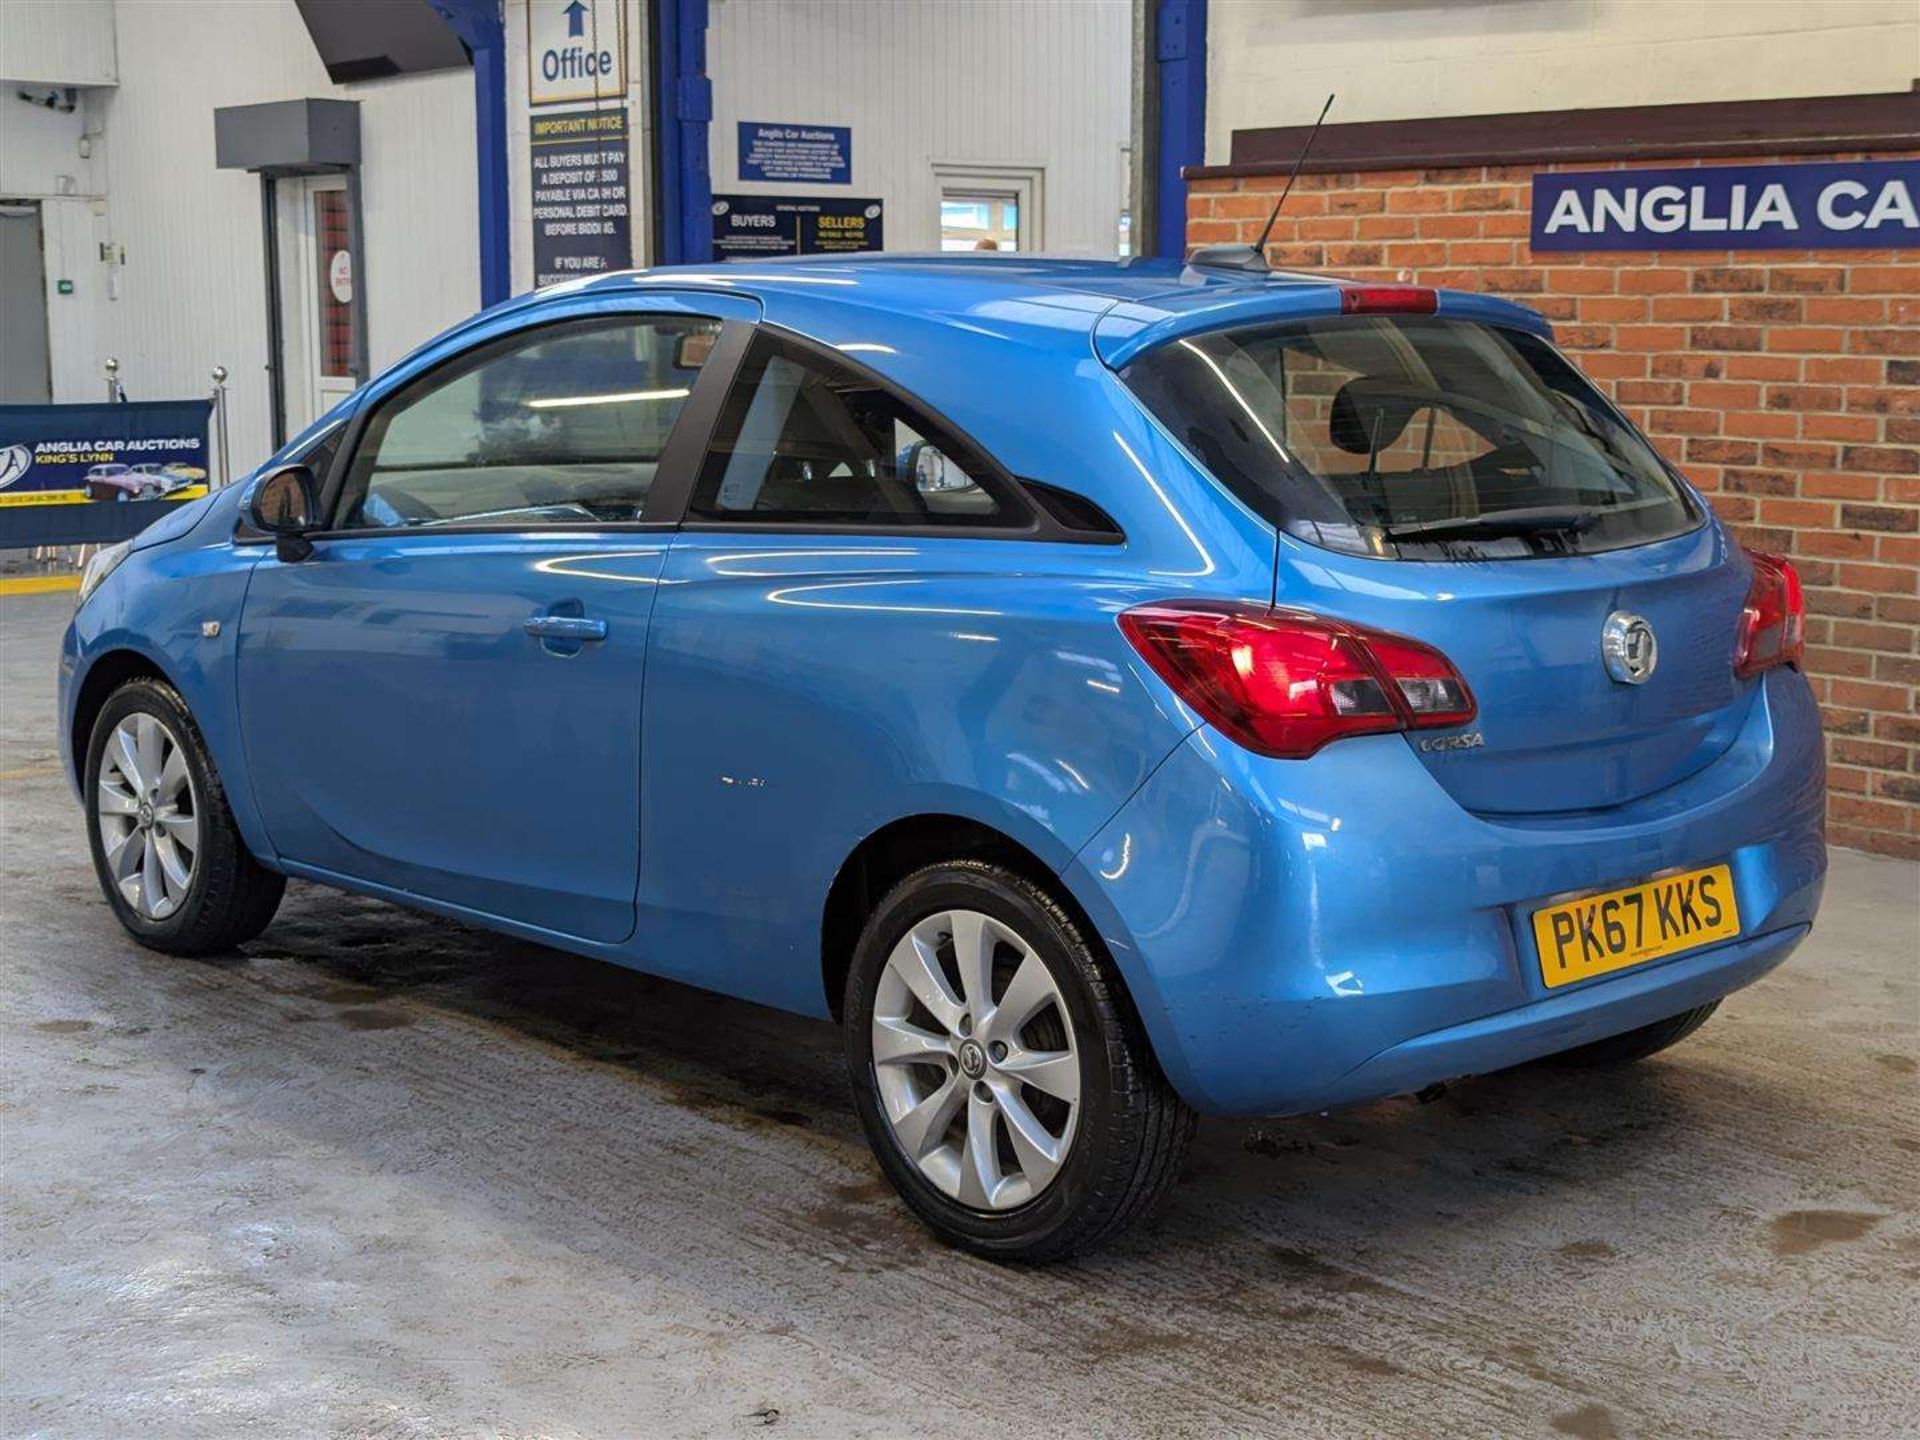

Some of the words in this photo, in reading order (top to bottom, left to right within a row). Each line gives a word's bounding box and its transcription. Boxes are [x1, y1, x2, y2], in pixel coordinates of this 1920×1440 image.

[543, 46, 611, 82] Office
[535, 119, 586, 135] IMPORTANT
[587, 116, 623, 131] NOTICE
[534, 156, 549, 169] ALL
[550, 154, 582, 168] BUYERS
[607, 151, 625, 165] PAY
[541, 173, 548, 185] A
[549, 171, 584, 185] DEPOSIT
[584, 170, 596, 183] OF
[597, 169, 618, 183] 500
[535, 188, 571, 202] PAYABLE
[572, 188, 586, 200] VIA
[612, 185, 626, 199] OR
[533, 205, 575, 219] PERSONAL
[576, 204, 601, 218] DEBIT
[1544, 183, 1799, 233] ANGLIA
[731, 214, 776, 228] BUYERS
[818, 215, 865, 229] SELLERS
[545, 223, 577, 236] BEFORE
[554, 257, 563, 269] IF
[563, 256, 581, 269] YOU
[582, 256, 600, 269] ARE
[35, 442, 92, 454] ANGLIA
[93, 440, 125, 452] CAR
[126, 438, 200, 451] AUCTIONS
[35, 452, 79, 464] KING'S
[80, 452, 114, 463] LYNN
[1420, 732, 1485, 752] CORSA
[1550, 891, 1645, 969] PK67
[1653, 874, 1722, 941] KKS
